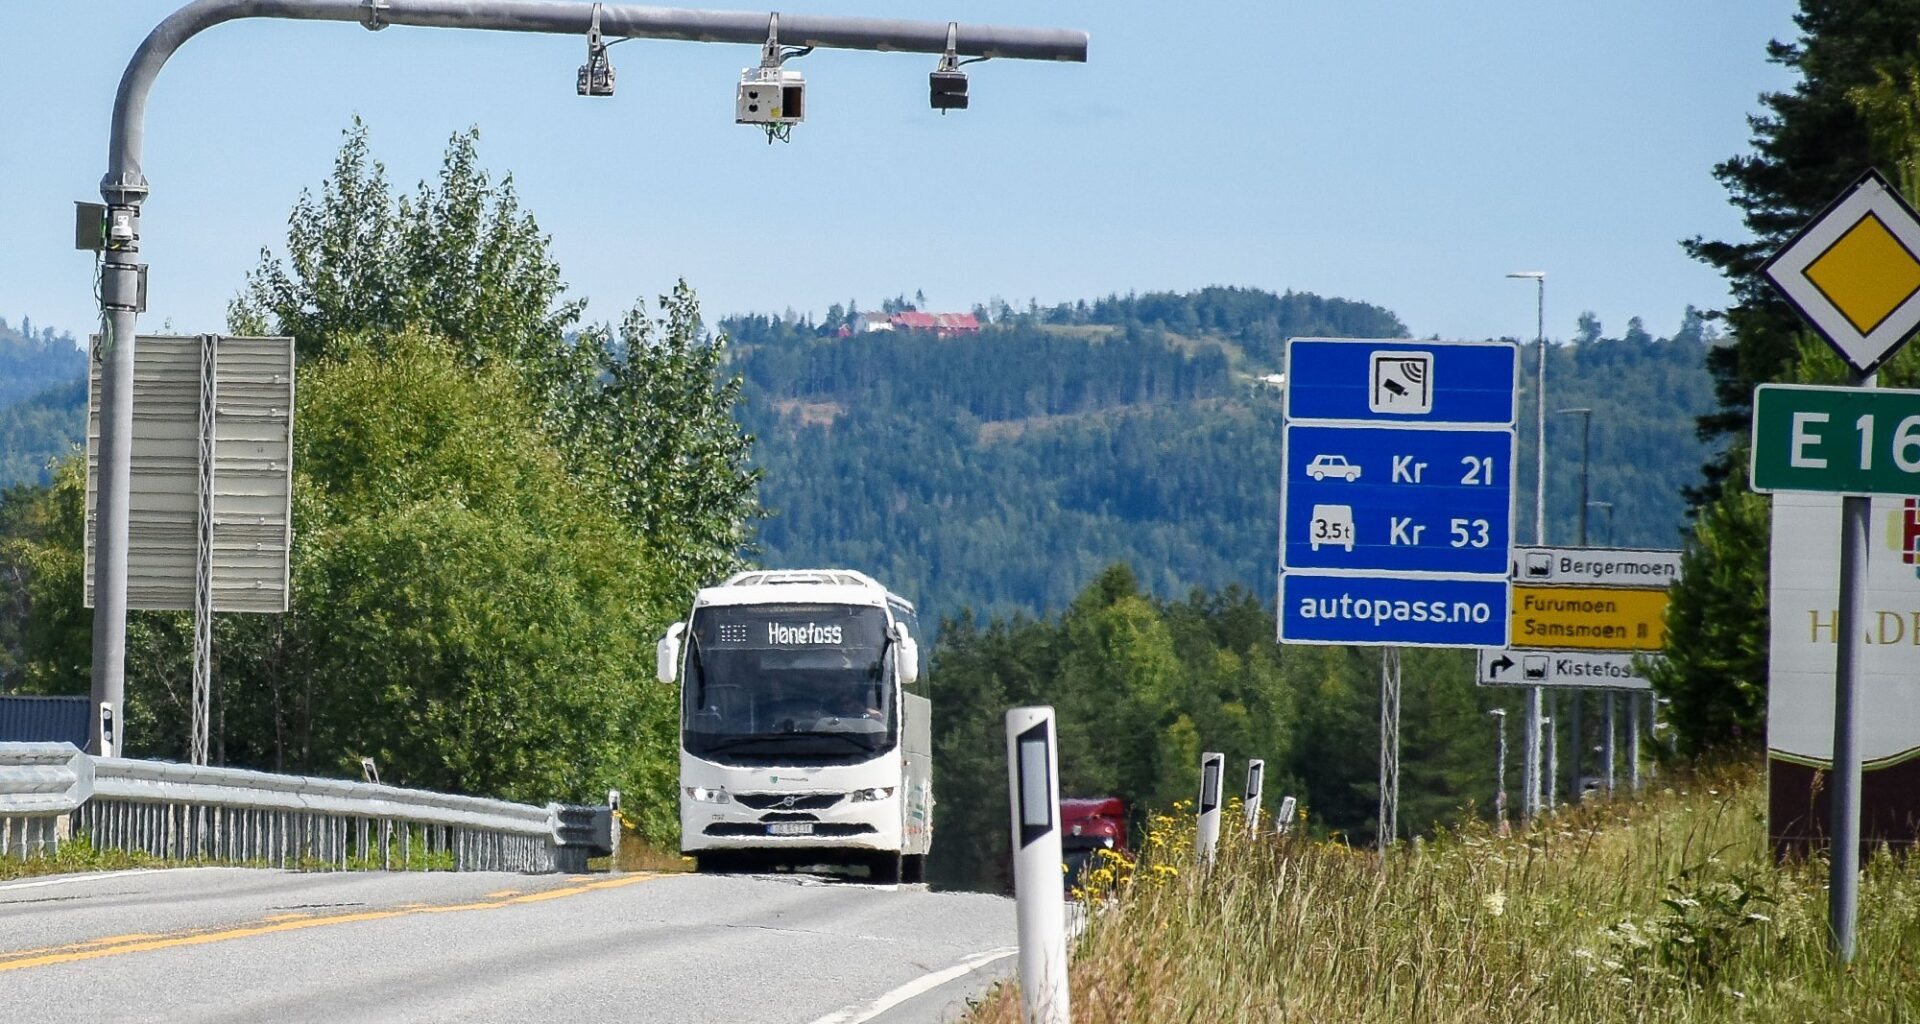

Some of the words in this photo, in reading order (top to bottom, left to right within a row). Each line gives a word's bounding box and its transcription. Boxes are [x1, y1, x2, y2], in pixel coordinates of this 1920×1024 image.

[1790, 411, 1830, 469] E
[1855, 413, 1920, 473] 16
[1392, 455, 1427, 483] Kr
[1461, 456, 1493, 485] 21
[1390, 517, 1425, 546] Kr
[1450, 518, 1490, 548] 53
[1560, 558, 1675, 577] Bergermoen
[1299, 593, 1490, 626] autopass.no
[1525, 595, 1616, 613] Furumoen
[768, 622, 842, 644] Hønefoss
[1525, 619, 1625, 638] Samsmoen
[1809, 609, 1920, 645] HD
